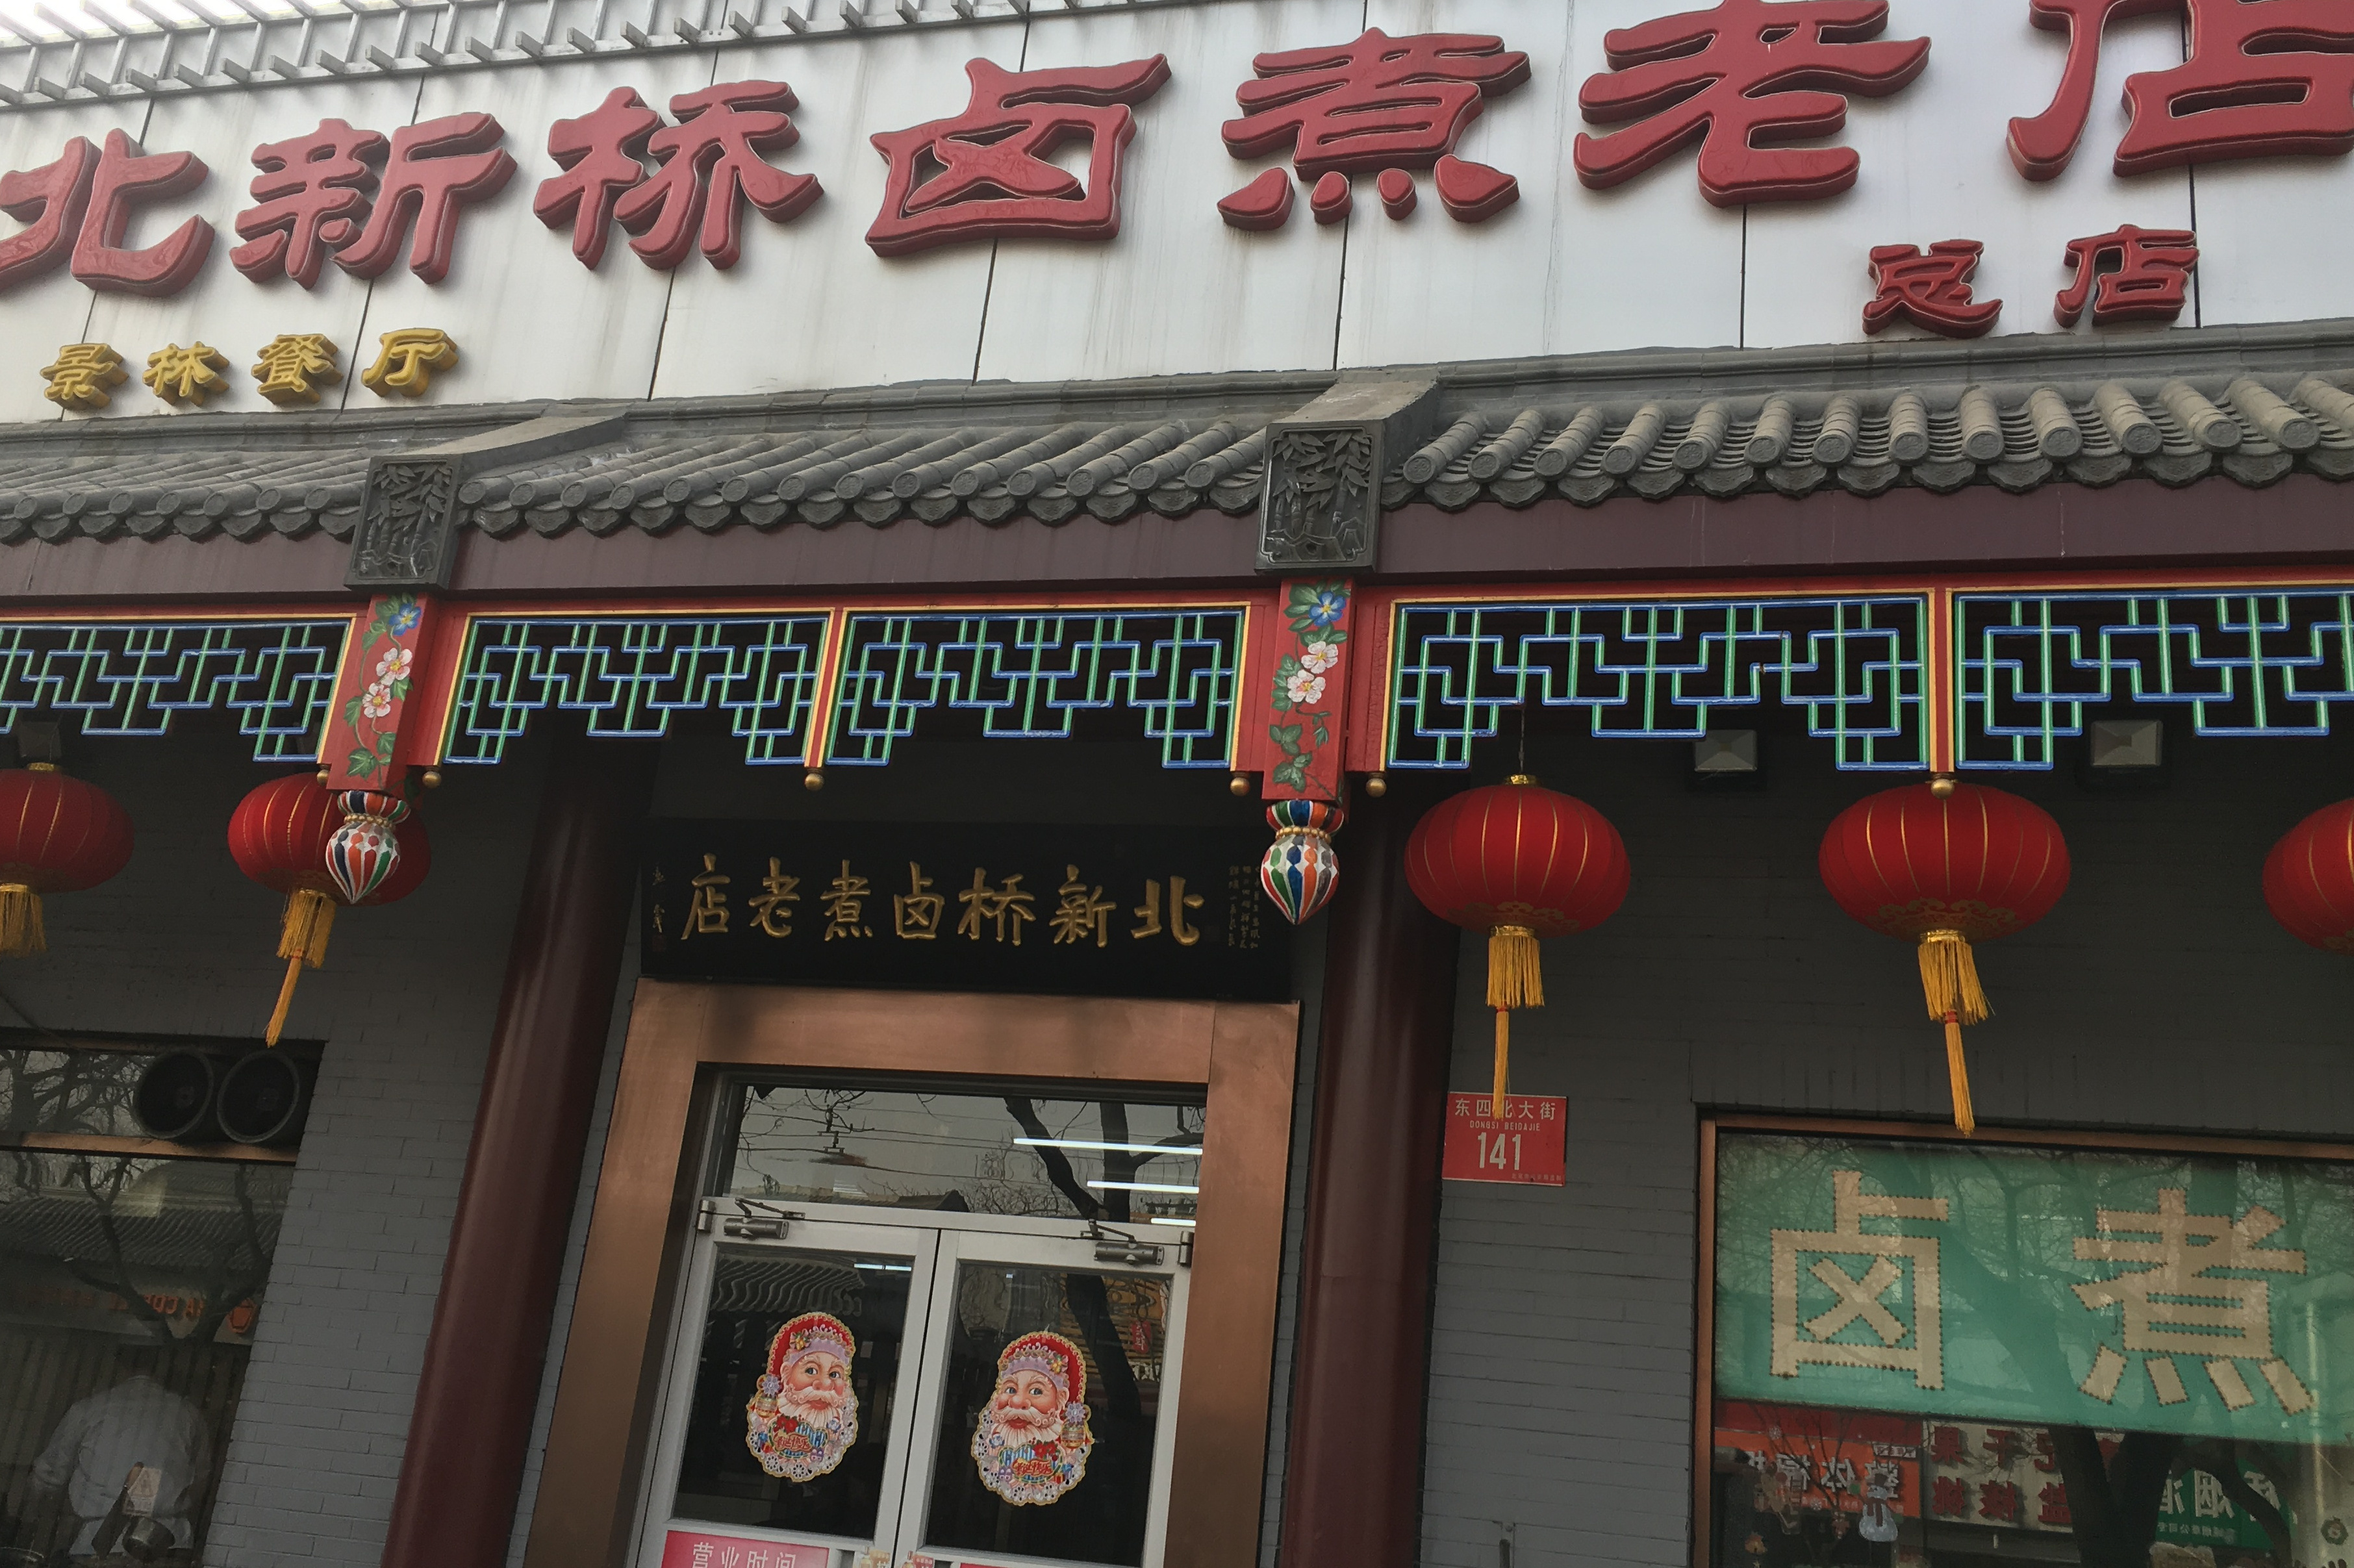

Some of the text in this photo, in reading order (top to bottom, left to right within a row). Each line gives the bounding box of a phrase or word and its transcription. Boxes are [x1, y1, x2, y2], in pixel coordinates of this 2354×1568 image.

[0, 0, 2354, 297] 北新桥卤煮老店
[40, 327, 457, 409] 景林餐厅
[1469, 1120, 1541, 1131] DONGSI BEIDAJIE
[1477, 1132, 1521, 1170] 141
[1769, 1170, 2318, 1417] 卤煮
